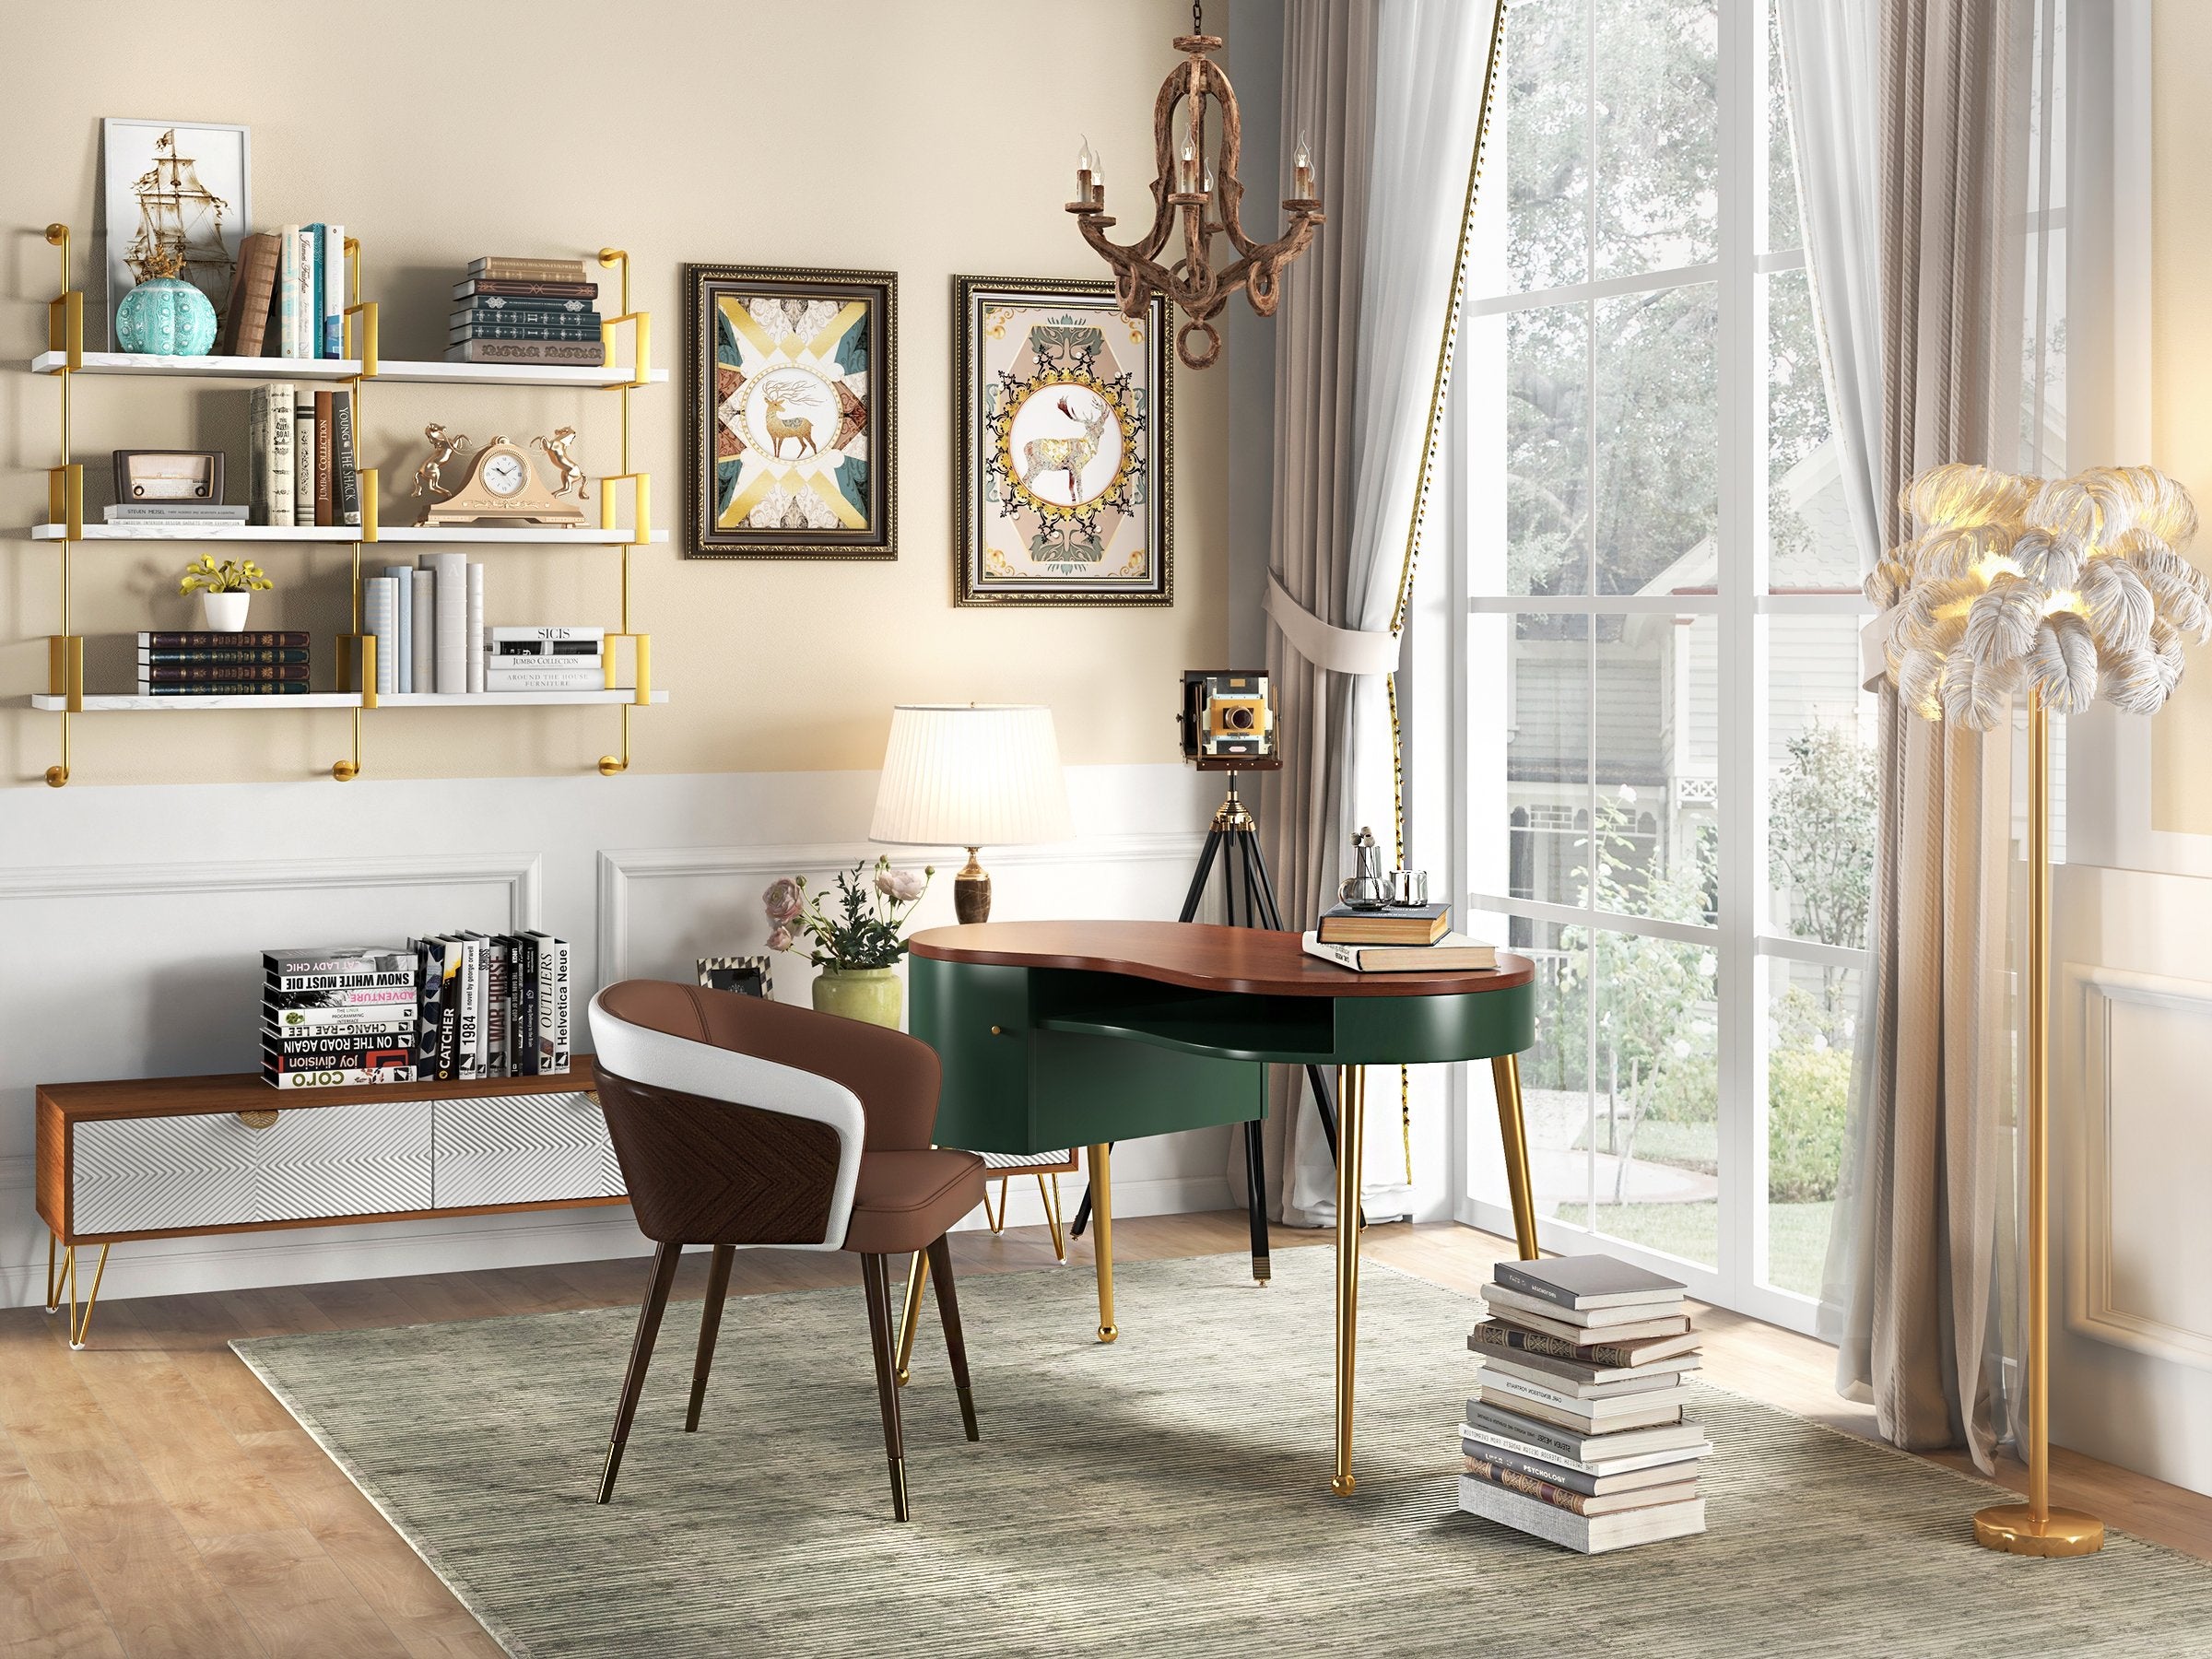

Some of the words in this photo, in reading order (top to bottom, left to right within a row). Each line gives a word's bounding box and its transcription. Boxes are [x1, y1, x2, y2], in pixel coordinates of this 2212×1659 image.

[339, 406, 350, 441] YOUNG
[319, 419, 327, 471] COLLECTION
[341, 449, 353, 468] THE
[319, 473, 329, 501] JUMBO
[343, 470, 356, 501] SHACK
[538, 629, 571, 640] SICIS
[513, 657, 535, 665] JUMBO
[287, 963, 311, 972] CHIC
[312, 962, 340, 971] LADY
[558, 950, 568, 982] Neue
[287, 978, 304, 990] DIE
[306, 976, 337, 989] MUST
[340, 974, 374, 987] WHITE
[376, 973, 409, 985] SNOW
[489, 956, 507, 1004] HORSE
[350, 991, 415, 1003] ADVENTURE
[540, 953, 553, 1029] OUTLIERS
[558, 986, 568, 1046] Helvetica
[288, 1027, 311, 1037] LEE
[316, 1023, 387, 1034] CHANG-RAE
[462, 1016, 477, 1046] 1984
[489, 1009, 505, 1042] WAR
[354, 1038, 374, 1050] THE
[377, 1036, 393, 1048] ON
[440, 1008, 454, 1069] CATCHER
[284, 1041, 318, 1053] AGAIN
[321, 1039, 350, 1052] ROAD
[289, 1055, 336, 1069] division
[340, 1055, 359, 1068] joy
[292, 1071, 345, 1088] coro
[1524, 1465, 1566, 1484] PSYCHOLOGY
